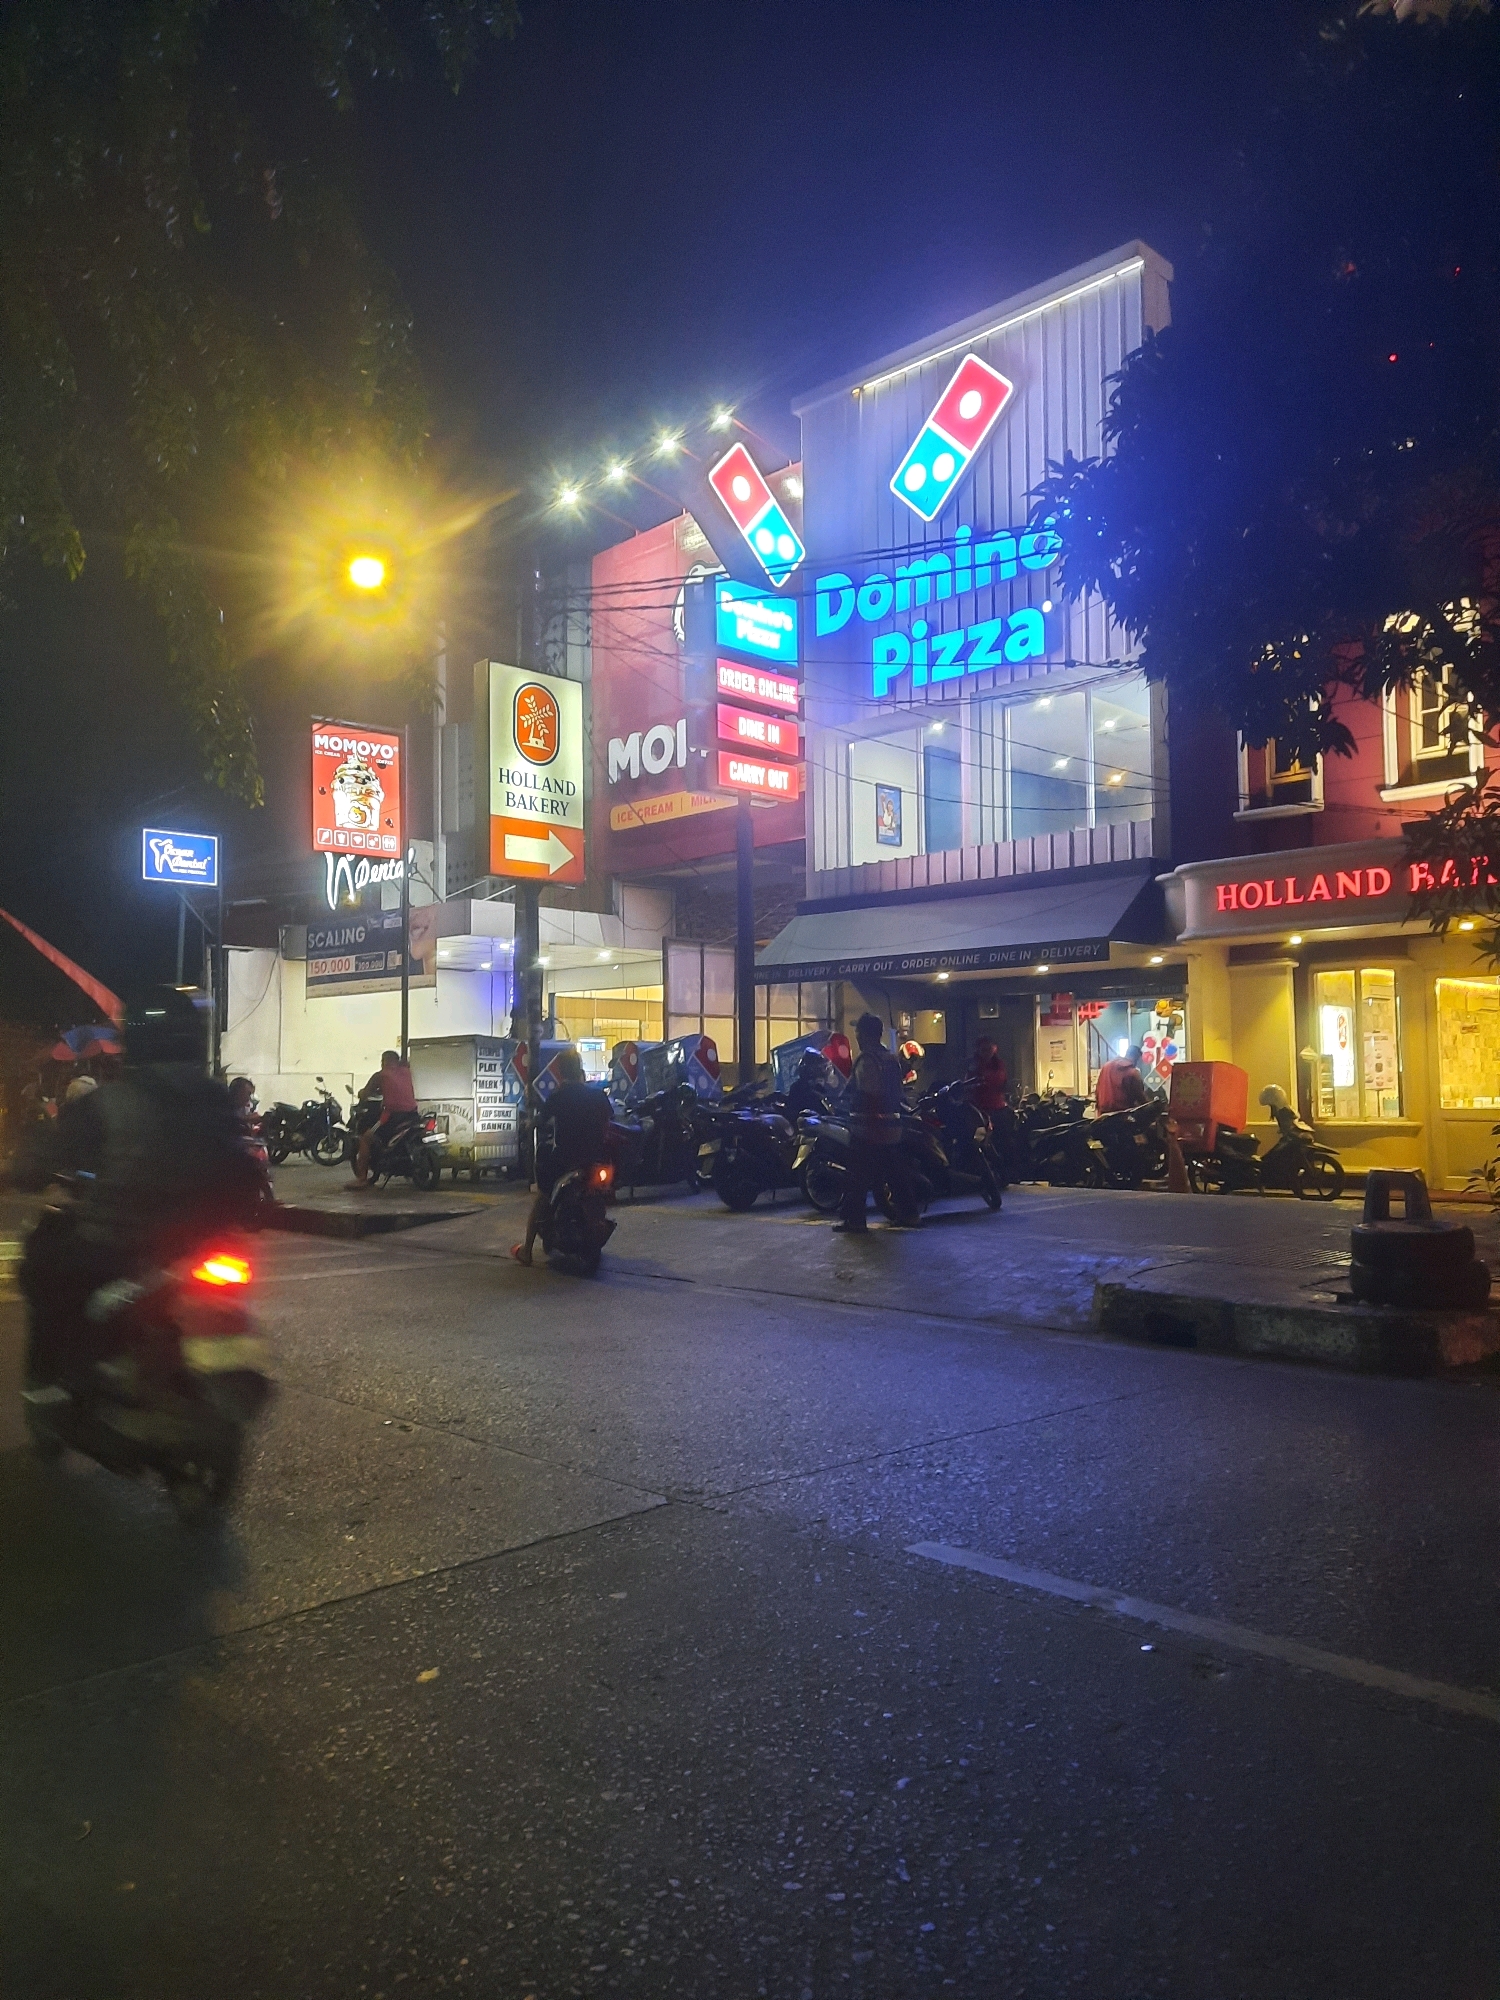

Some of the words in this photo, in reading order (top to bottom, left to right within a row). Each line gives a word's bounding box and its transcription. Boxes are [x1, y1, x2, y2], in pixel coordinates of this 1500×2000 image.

[872, 608, 1045, 698] Pizza
[719, 667, 755, 693] ORDER
[758, 678, 797, 705] ONLINE
[738, 716, 766, 741] DINE
[768, 724, 780, 744] IN
[314, 734, 394, 759] MOMOYO
[499, 768, 576, 796] HOLLAND
[729, 761, 766, 785] CARRY
[768, 769, 789, 791] OUT
[505, 791, 570, 816] BAKERY
[617, 810, 633, 823] ICE
[637, 802, 673, 819] CREAM
[1216, 867, 1392, 912] HOLLAND
[307, 926, 366, 949] SCALING
[310, 958, 351, 975] 150.000
[788, 966, 832, 979] DELIVERY
[839, 962, 871, 975] CARRY
[873, 960, 894, 972] OUT
[901, 956, 937, 969] ORDER
[939, 953, 980, 967] ONLINE
[989, 951, 1016, 963] DINE
[1019, 950, 1031, 960] IN
[1041, 944, 1101, 960] DELIVERY
